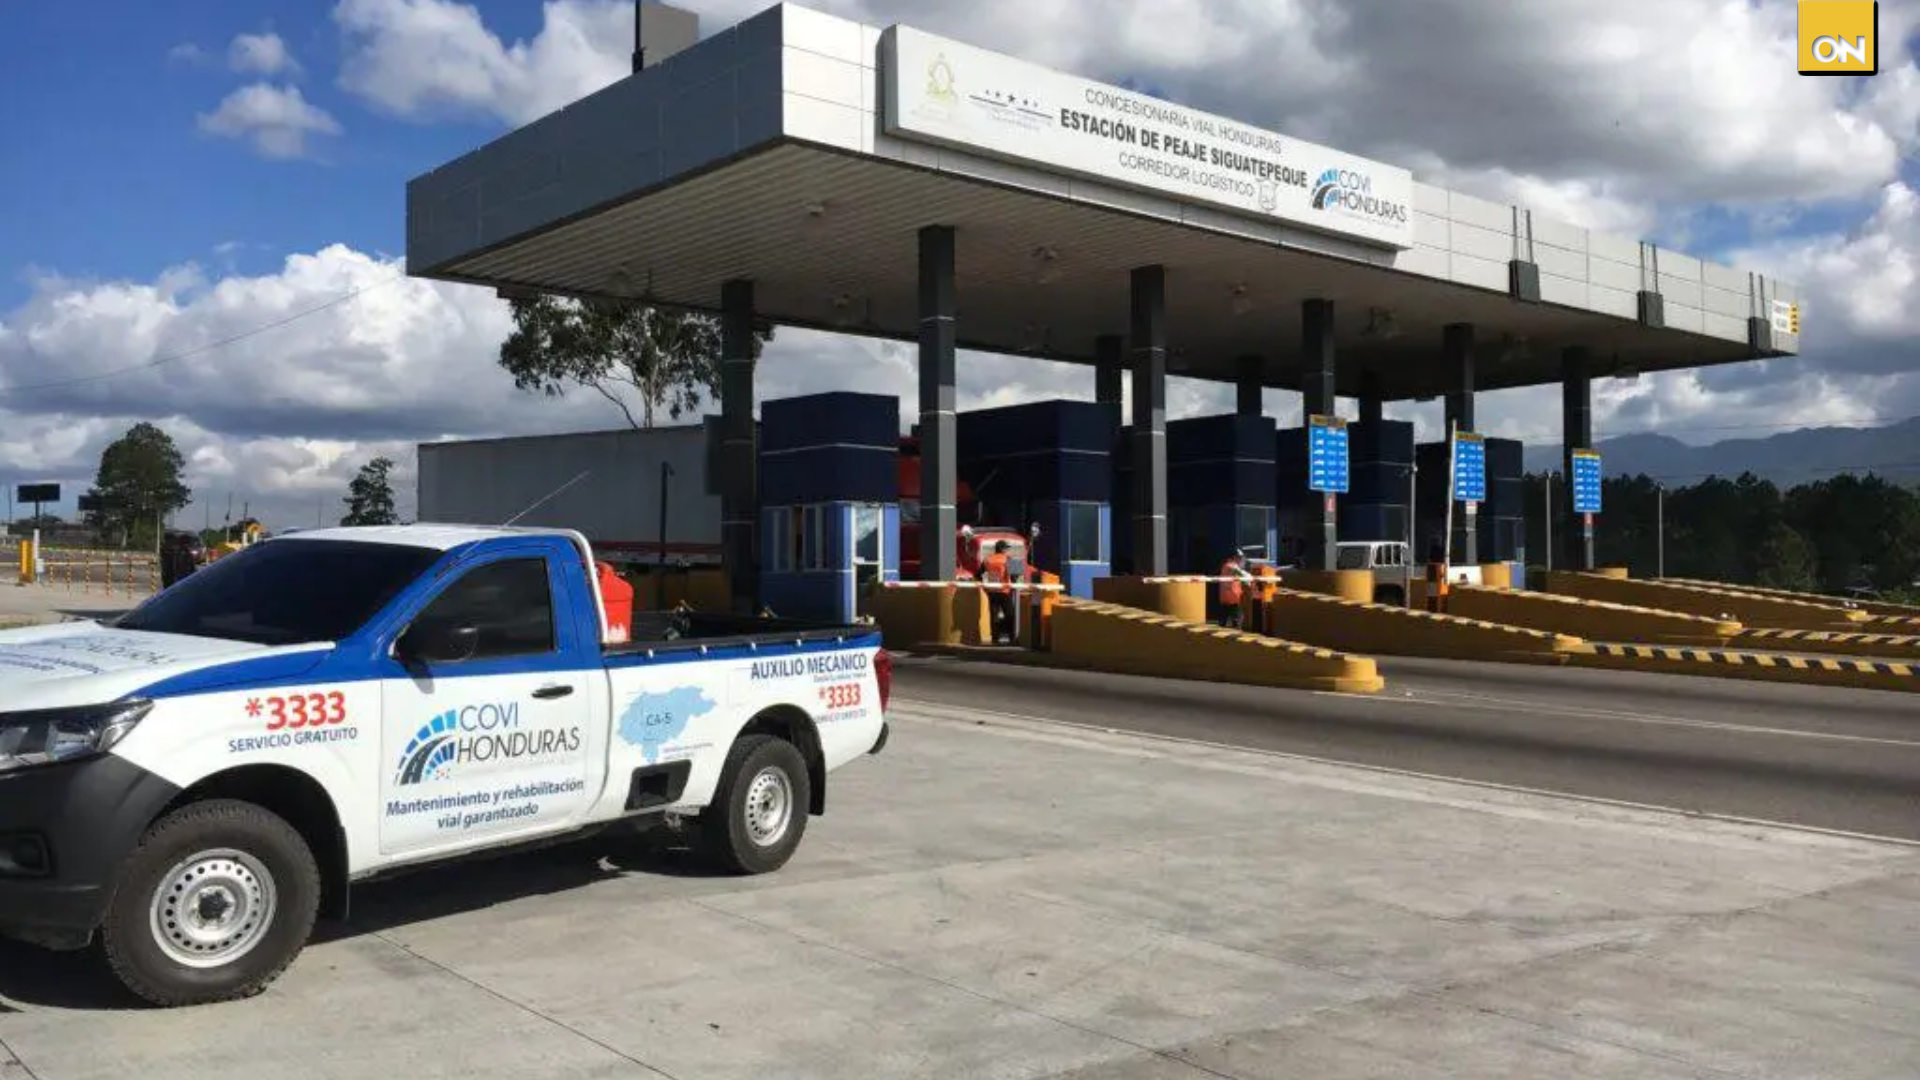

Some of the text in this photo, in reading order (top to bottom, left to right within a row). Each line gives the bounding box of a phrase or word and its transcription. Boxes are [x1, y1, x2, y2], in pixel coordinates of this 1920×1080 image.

[1085, 88, 1189, 128] CONCESIONARIA
[1192, 119, 1217, 137] VIAL
[1218, 124, 1281, 155] HONDURAS
[1060, 108, 1136, 144] ESTACIÓN
[1141, 129, 1160, 150] DE
[1164, 135, 1207, 162] PEAJE
[1210, 147, 1307, 188] SIGUATEPEQUE
[1119, 152, 1190, 181] CORREDOR
[1339, 170, 1371, 194] COVI
[1337, 192, 1407, 223] HONDURAS
[751, 658, 804, 680] AUXILIO
[459, 701, 519, 732] COVI
[229, 727, 357, 752] SERVICIO GRATUITO
[457, 727, 581, 763] HONDURAS
[386, 778, 584, 816] Mantenimiento y rehabilitación
[437, 803, 539, 829] vial garantizado
